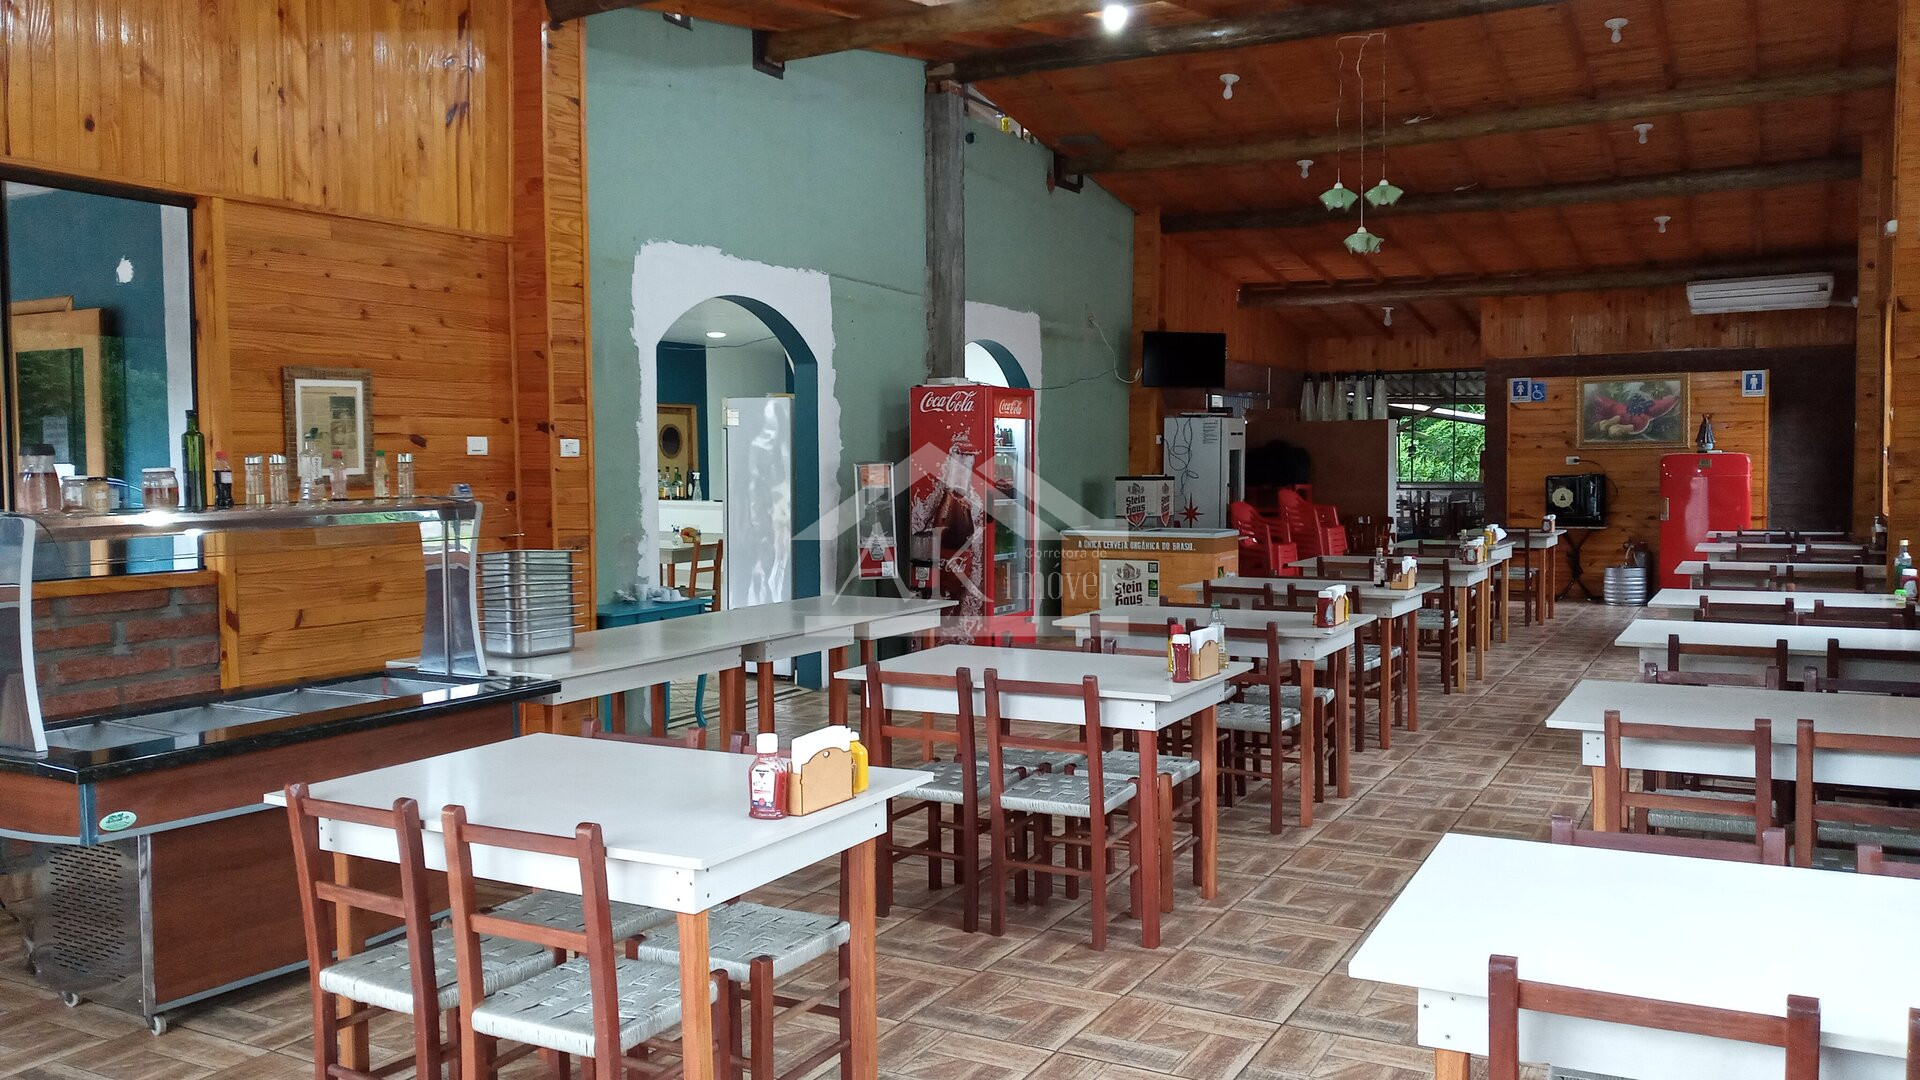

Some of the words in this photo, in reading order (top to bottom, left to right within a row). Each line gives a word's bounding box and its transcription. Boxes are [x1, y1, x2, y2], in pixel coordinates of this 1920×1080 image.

[920, 390, 977, 413] Coca-Cola
[999, 399, 1024, 415] Coca-Cola
[1126, 495, 1146, 507] Stein
[1078, 540, 1083, 548] A
[1161, 542, 1170, 551] DO
[1114, 580, 1142, 595] Stein
[1115, 593, 1143, 606] haus
